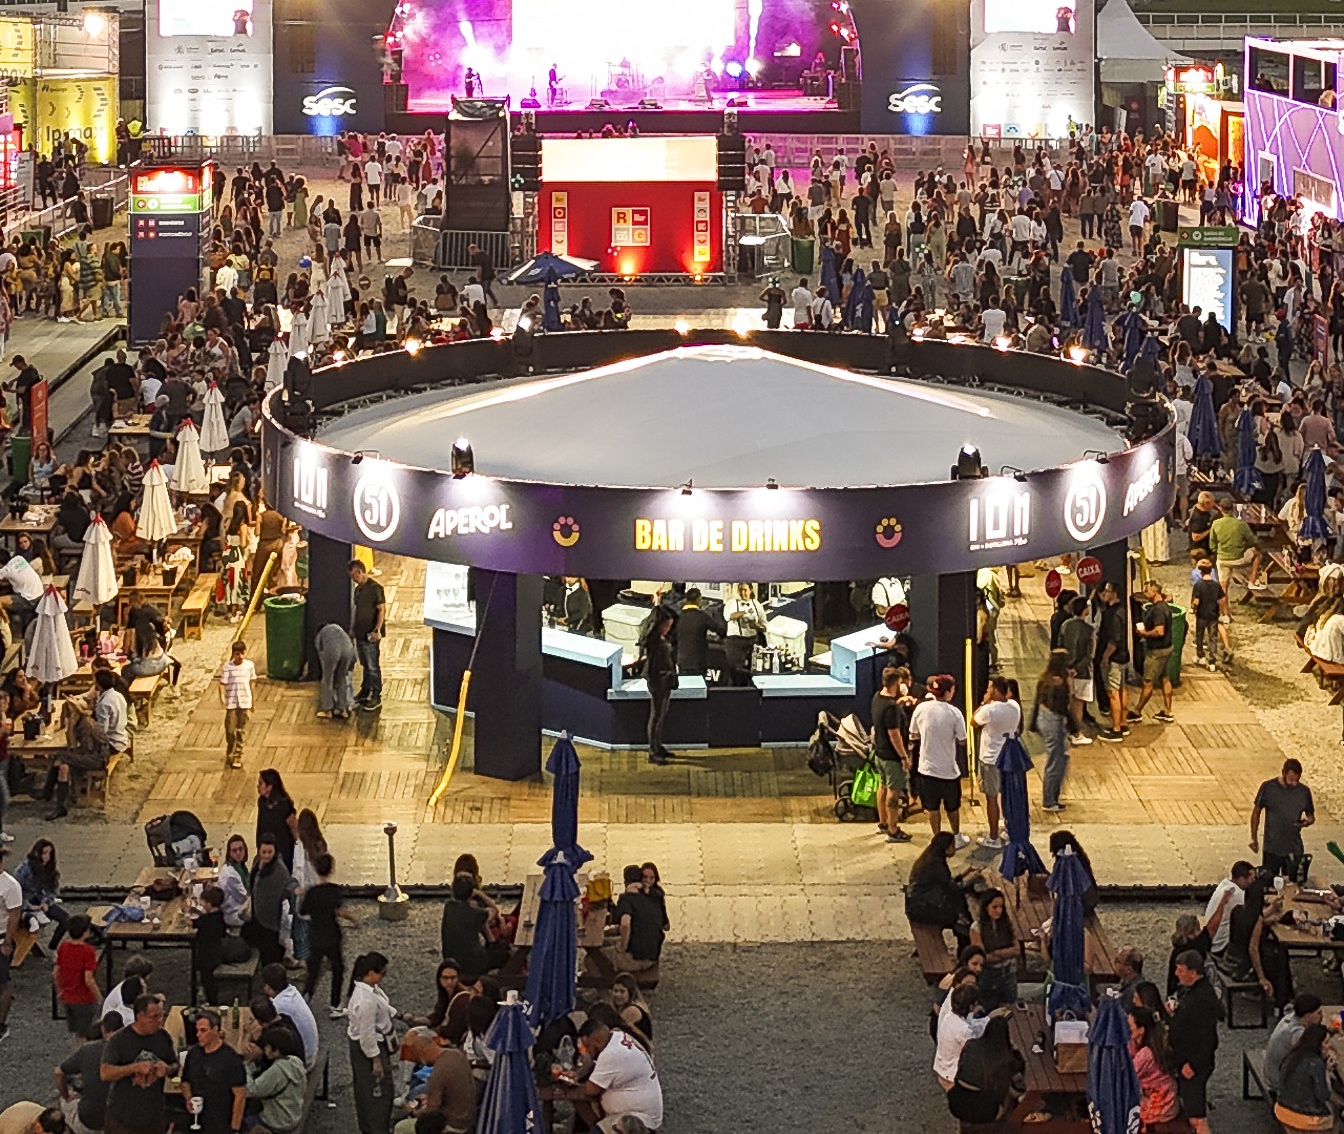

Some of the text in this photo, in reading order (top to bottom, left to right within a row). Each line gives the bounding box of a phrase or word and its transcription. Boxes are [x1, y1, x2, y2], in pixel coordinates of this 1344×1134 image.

[887, 84, 942, 114] Sesc
[364, 485, 388, 527] 51
[428, 504, 513, 539] APEROL
[1075, 485, 1097, 527] 51
[635, 519, 821, 551] BAR DE DRINKS
[1078, 563, 1101, 578] CAIXA
